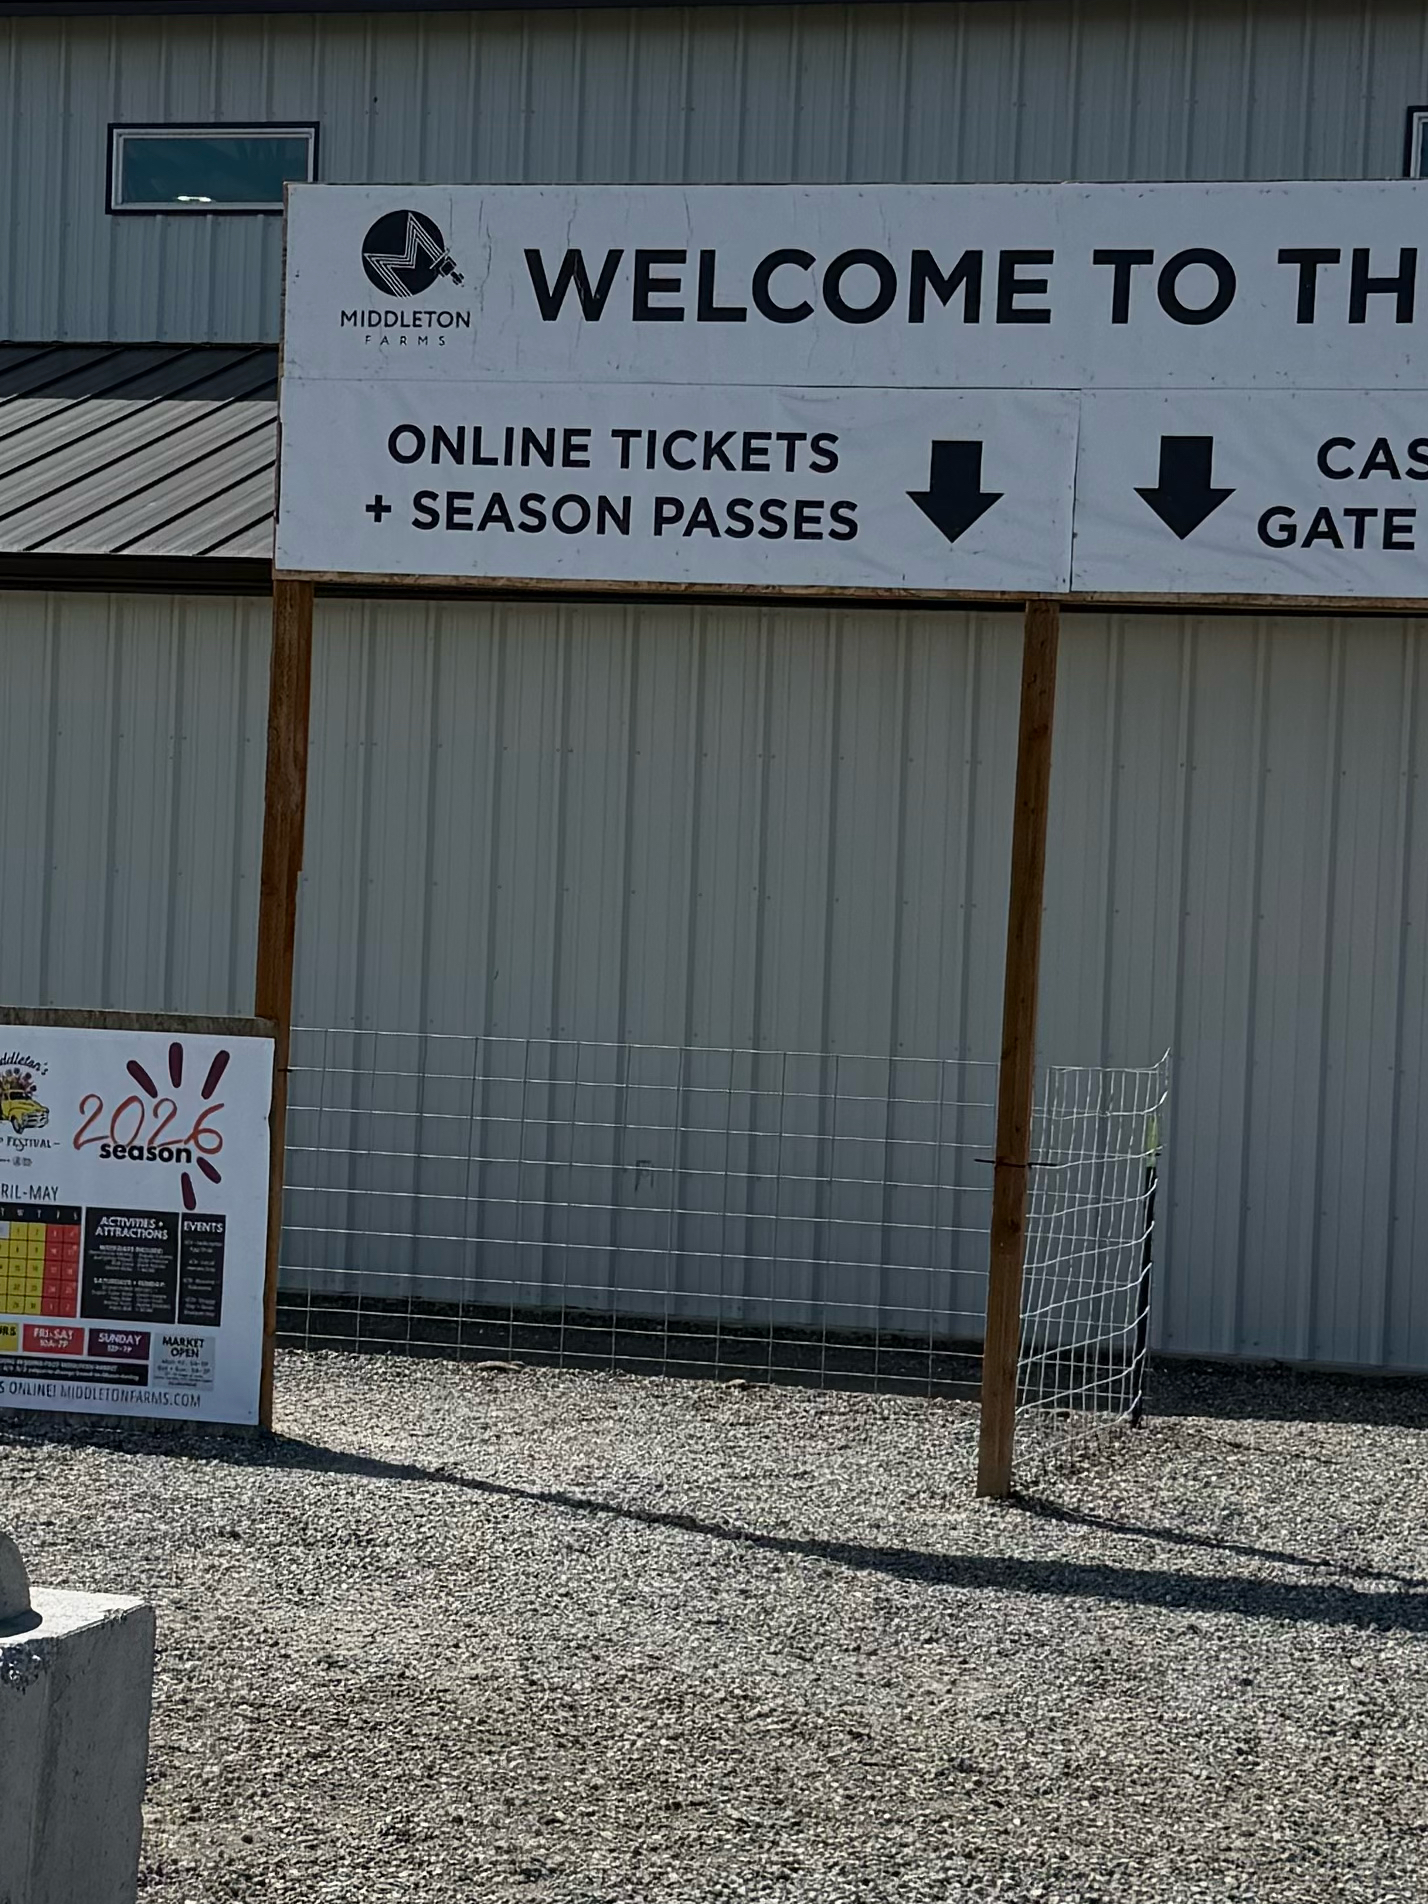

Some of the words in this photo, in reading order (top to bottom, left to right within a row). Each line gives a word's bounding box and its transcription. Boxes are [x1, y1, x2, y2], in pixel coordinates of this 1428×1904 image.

[523, 248, 1055, 325] WELCOME
[1092, 247, 1237, 326] TO
[340, 309, 471, 329] MIDDLETON
[365, 335, 446, 346] FARMS
[387, 423, 592, 468] ONLINE
[610, 428, 839, 474] TICKETS
[365, 494, 392, 523] +
[411, 489, 632, 536] SEASON
[653, 496, 858, 541] PASSES
[1257, 505, 1417, 551] GATE
[73, 1093, 226, 1156] 2026
[6, 1136, 52, 1152] FESTIVAL
[99, 1141, 193, 1165] season
[99, 1216, 156, 1229] ACTIVITIES
[183, 1220, 224, 1234] EVENTS
[95, 1226, 169, 1241] ATTRACTIONS
[98, 1332, 142, 1346] SUNDAY
[162, 1335, 204, 1349] MARKET
[170, 1347, 200, 1359] OPEN
[60, 1384, 201, 1408] MIDDLETONFARMS.COM
